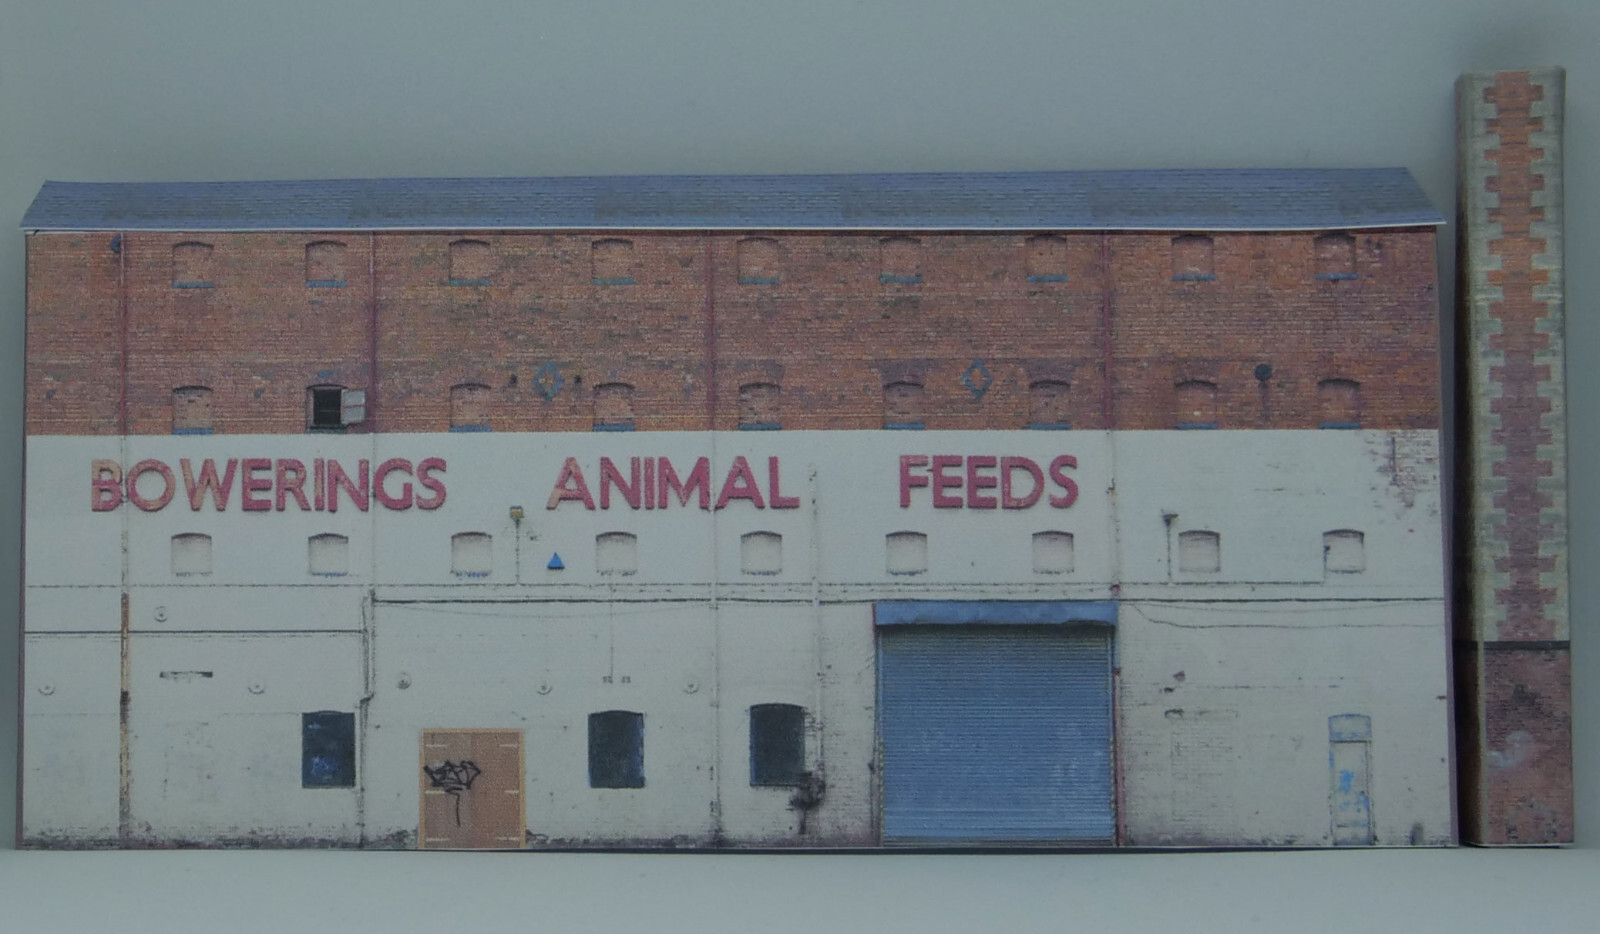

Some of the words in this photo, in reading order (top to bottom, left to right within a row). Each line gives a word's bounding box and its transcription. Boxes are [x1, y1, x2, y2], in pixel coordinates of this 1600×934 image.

[91, 458, 447, 512] BOWERINGS
[546, 456, 800, 510] ANIMAL
[899, 455, 1078, 510] FEEDS
